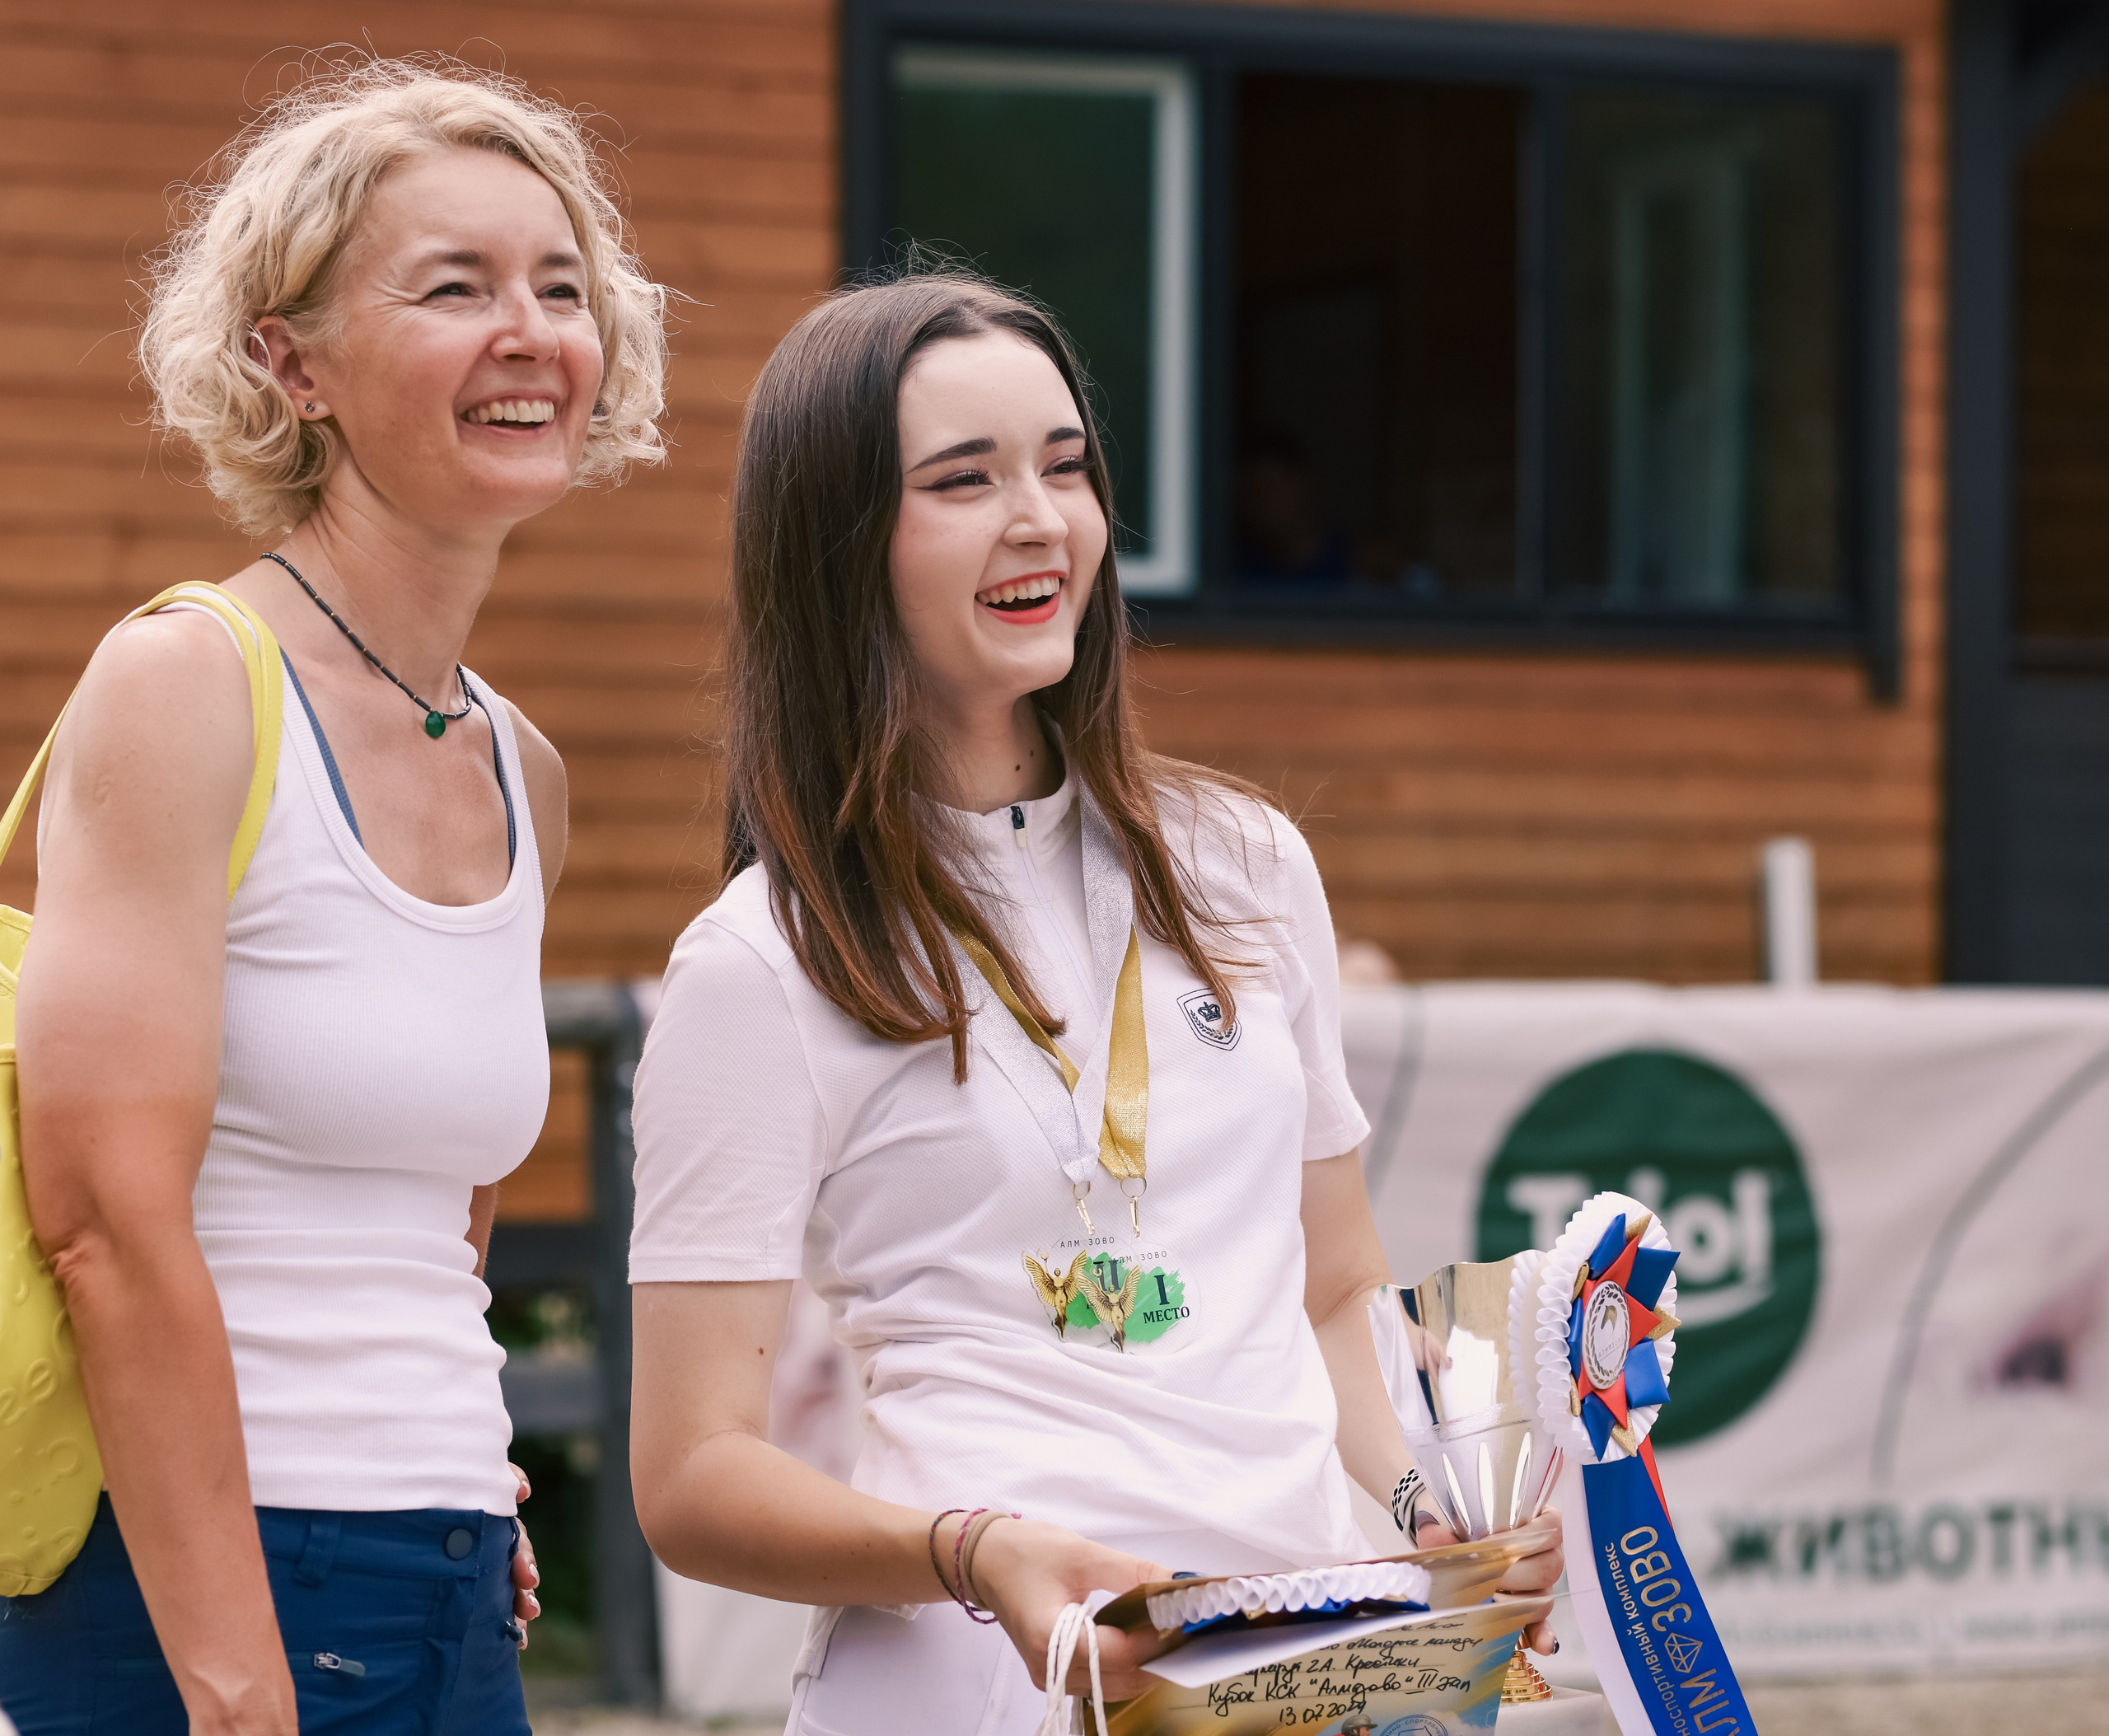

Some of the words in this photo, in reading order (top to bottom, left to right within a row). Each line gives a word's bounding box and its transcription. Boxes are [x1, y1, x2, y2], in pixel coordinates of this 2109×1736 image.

[1060, 1239, 1081, 1249] АЛМ
[1088, 1236, 1115, 1247] ЗОВО
[1140, 1250, 1168, 1261] ЗОВО
[1506, 1170, 1775, 1285] Tol
[1143, 1306, 1190, 1324] МЕСТО
[1710, 1502, 2109, 1584] ЖИВОТН
[1605, 1542, 1639, 1621] комплекс
[1620, 1525, 1692, 1632] ЗОВО
[1208, 1682, 1255, 1718] Кубок
[1680, 1668, 1741, 1736] ЛМ
